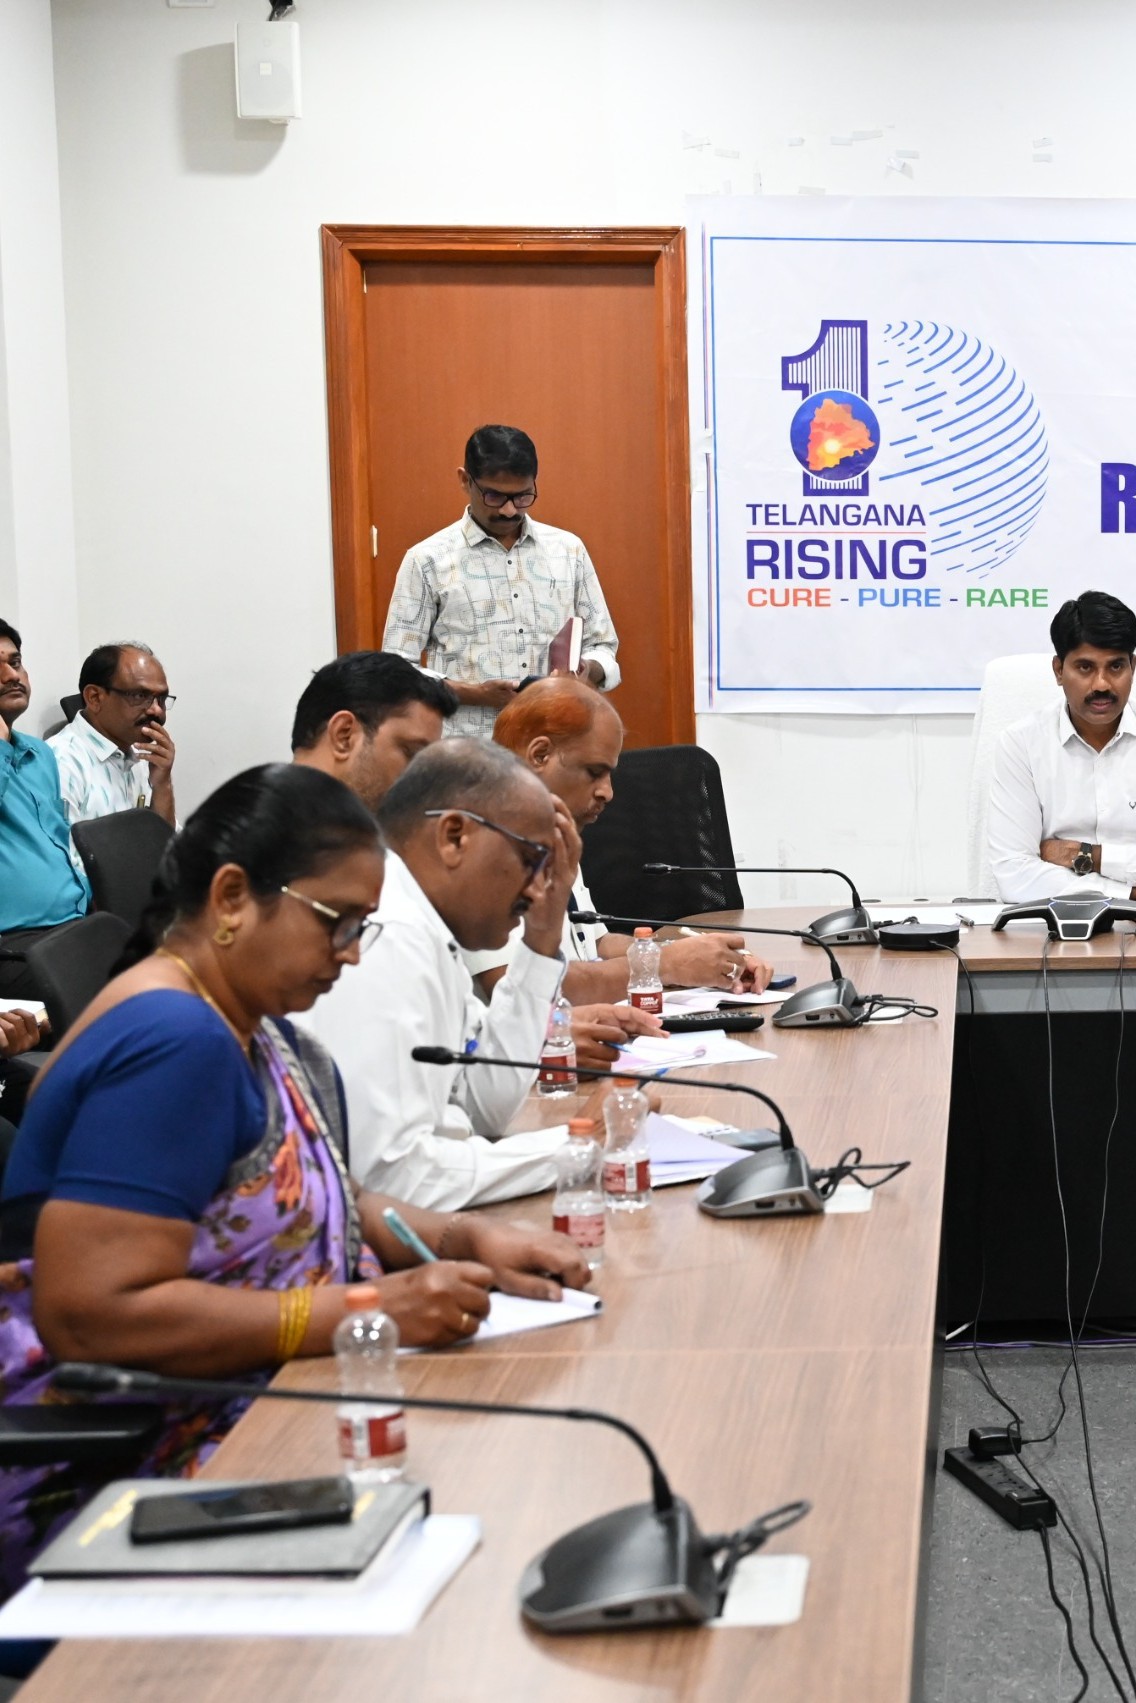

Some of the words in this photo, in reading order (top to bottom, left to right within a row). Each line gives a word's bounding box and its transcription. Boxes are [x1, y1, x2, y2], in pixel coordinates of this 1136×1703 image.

[746, 504, 926, 526] TELANGANA
[746, 539, 927, 580] RISING
[747, 588, 831, 608] CURE
[858, 588, 941, 607] PURE
[966, 588, 1049, 607] RARE
